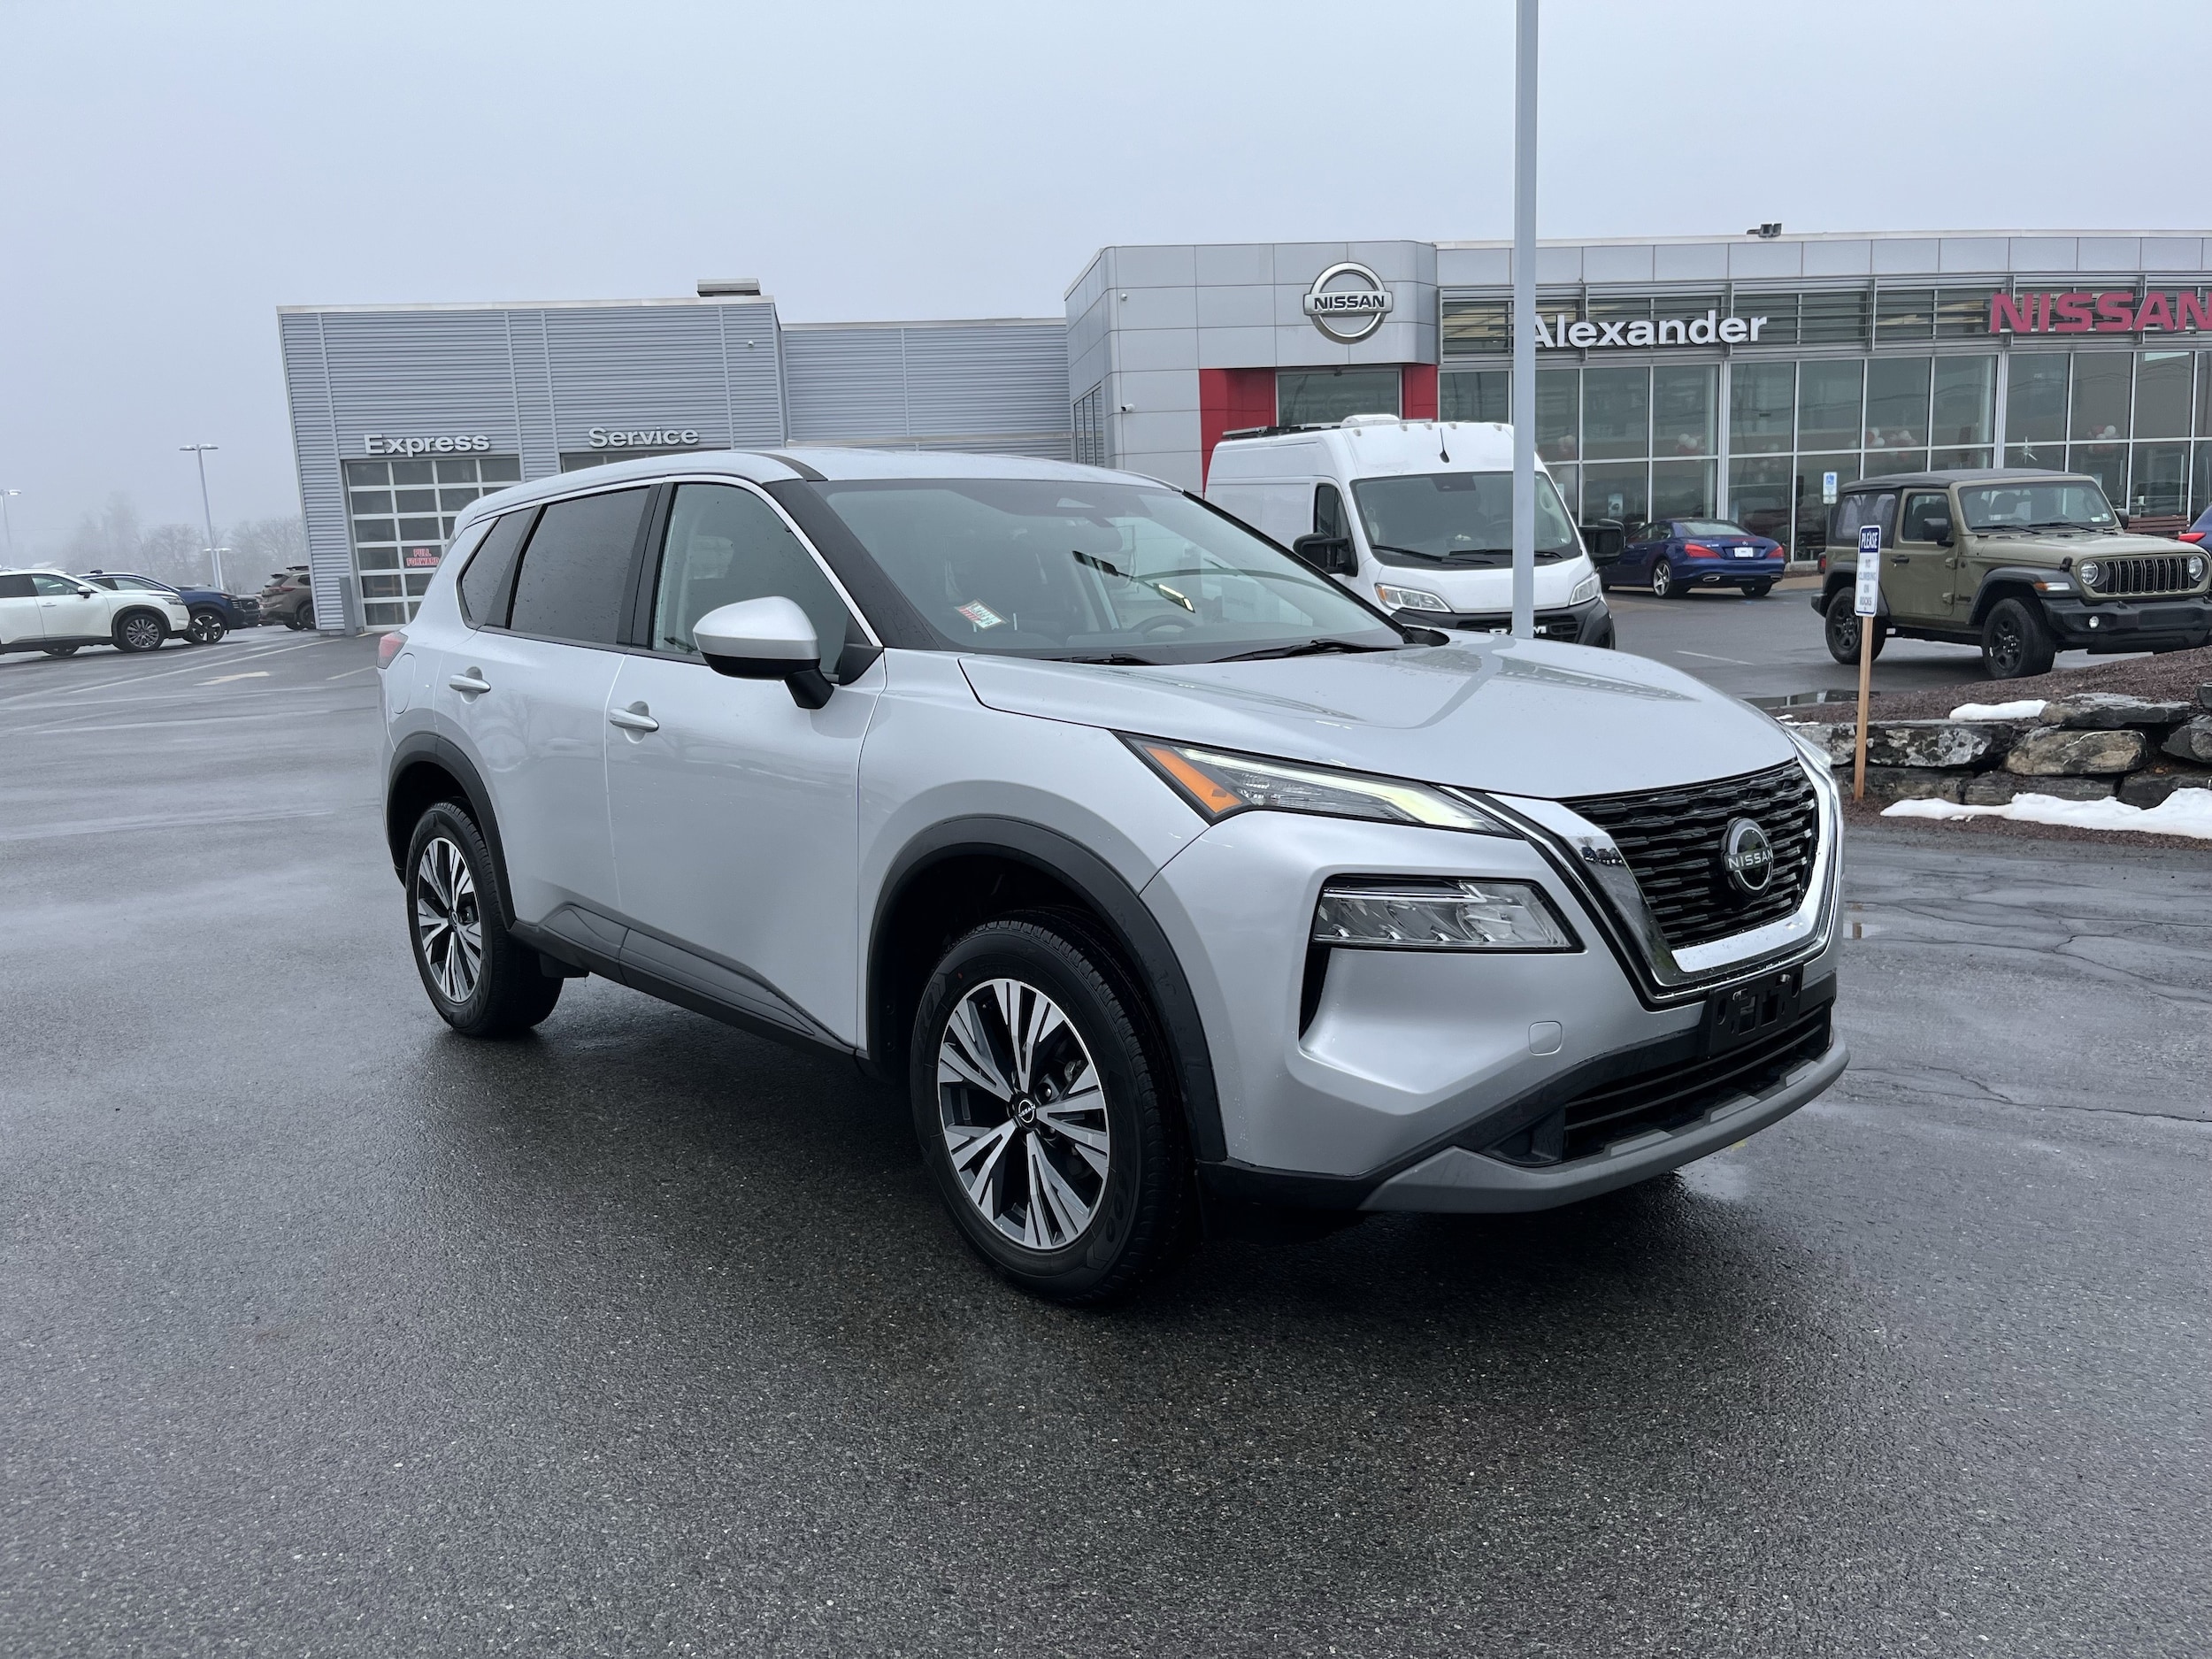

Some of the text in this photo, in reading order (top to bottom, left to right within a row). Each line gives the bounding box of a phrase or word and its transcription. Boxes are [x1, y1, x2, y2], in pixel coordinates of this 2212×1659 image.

[1314, 295, 1385, 310] NISSAN
[1990, 292, 2212, 334] NISSAN
[364, 434, 490, 457] Express
[588, 426, 699, 448] Service
[1861, 532, 1878, 549] PLEASE
[406, 557, 440, 566] FORWARD
[1489, 626, 1547, 635] RM
[1728, 849, 1773, 869] NISSAN
